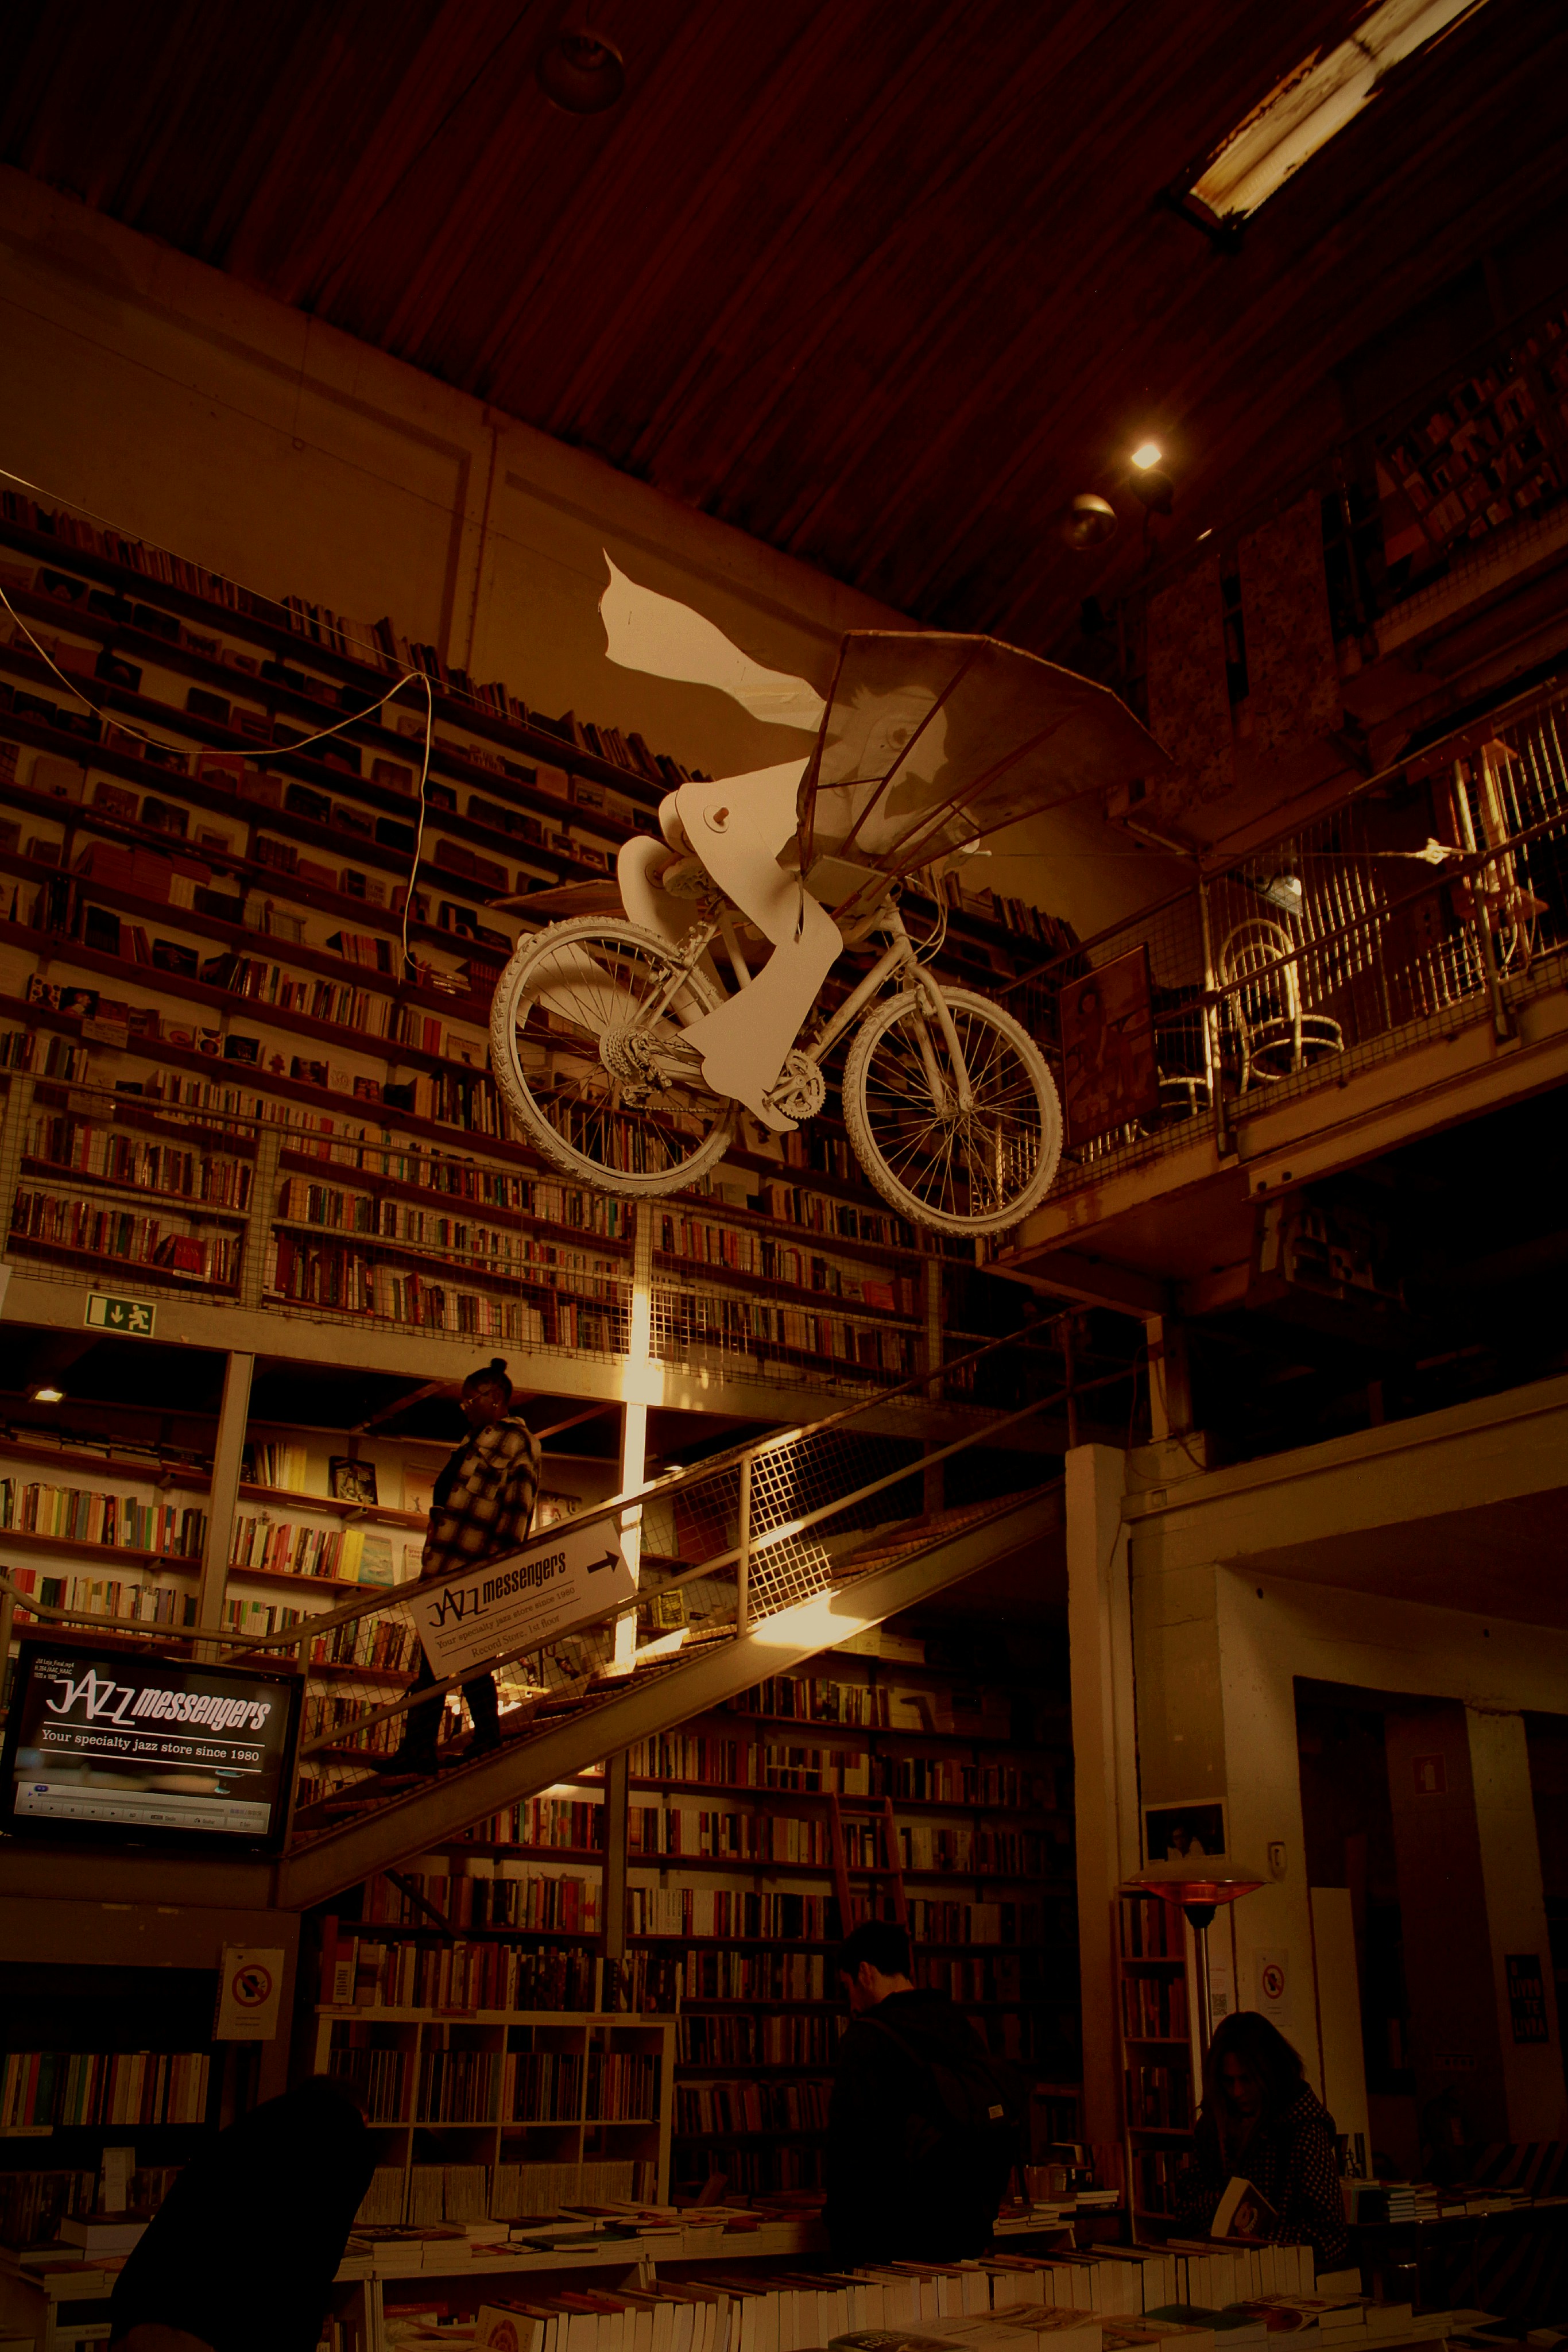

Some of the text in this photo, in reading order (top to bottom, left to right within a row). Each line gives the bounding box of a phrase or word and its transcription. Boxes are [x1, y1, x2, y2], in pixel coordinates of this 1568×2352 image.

[427, 1552, 566, 1627] JAZZ messengers
[436, 1587, 576, 1650] Your specialty jazz store since 1980
[471, 1638, 502, 1657] Record
[541, 1614, 560, 1628] floor
[46, 1669, 272, 1731] JAZZ messengers
[42, 1729, 260, 1761] Your specialty jazz store since 1980
[1510, 1978, 1542, 1999] LIVRO
[1524, 1999, 1540, 2016] TE
[1514, 2017, 1546, 2037] LIVRA
